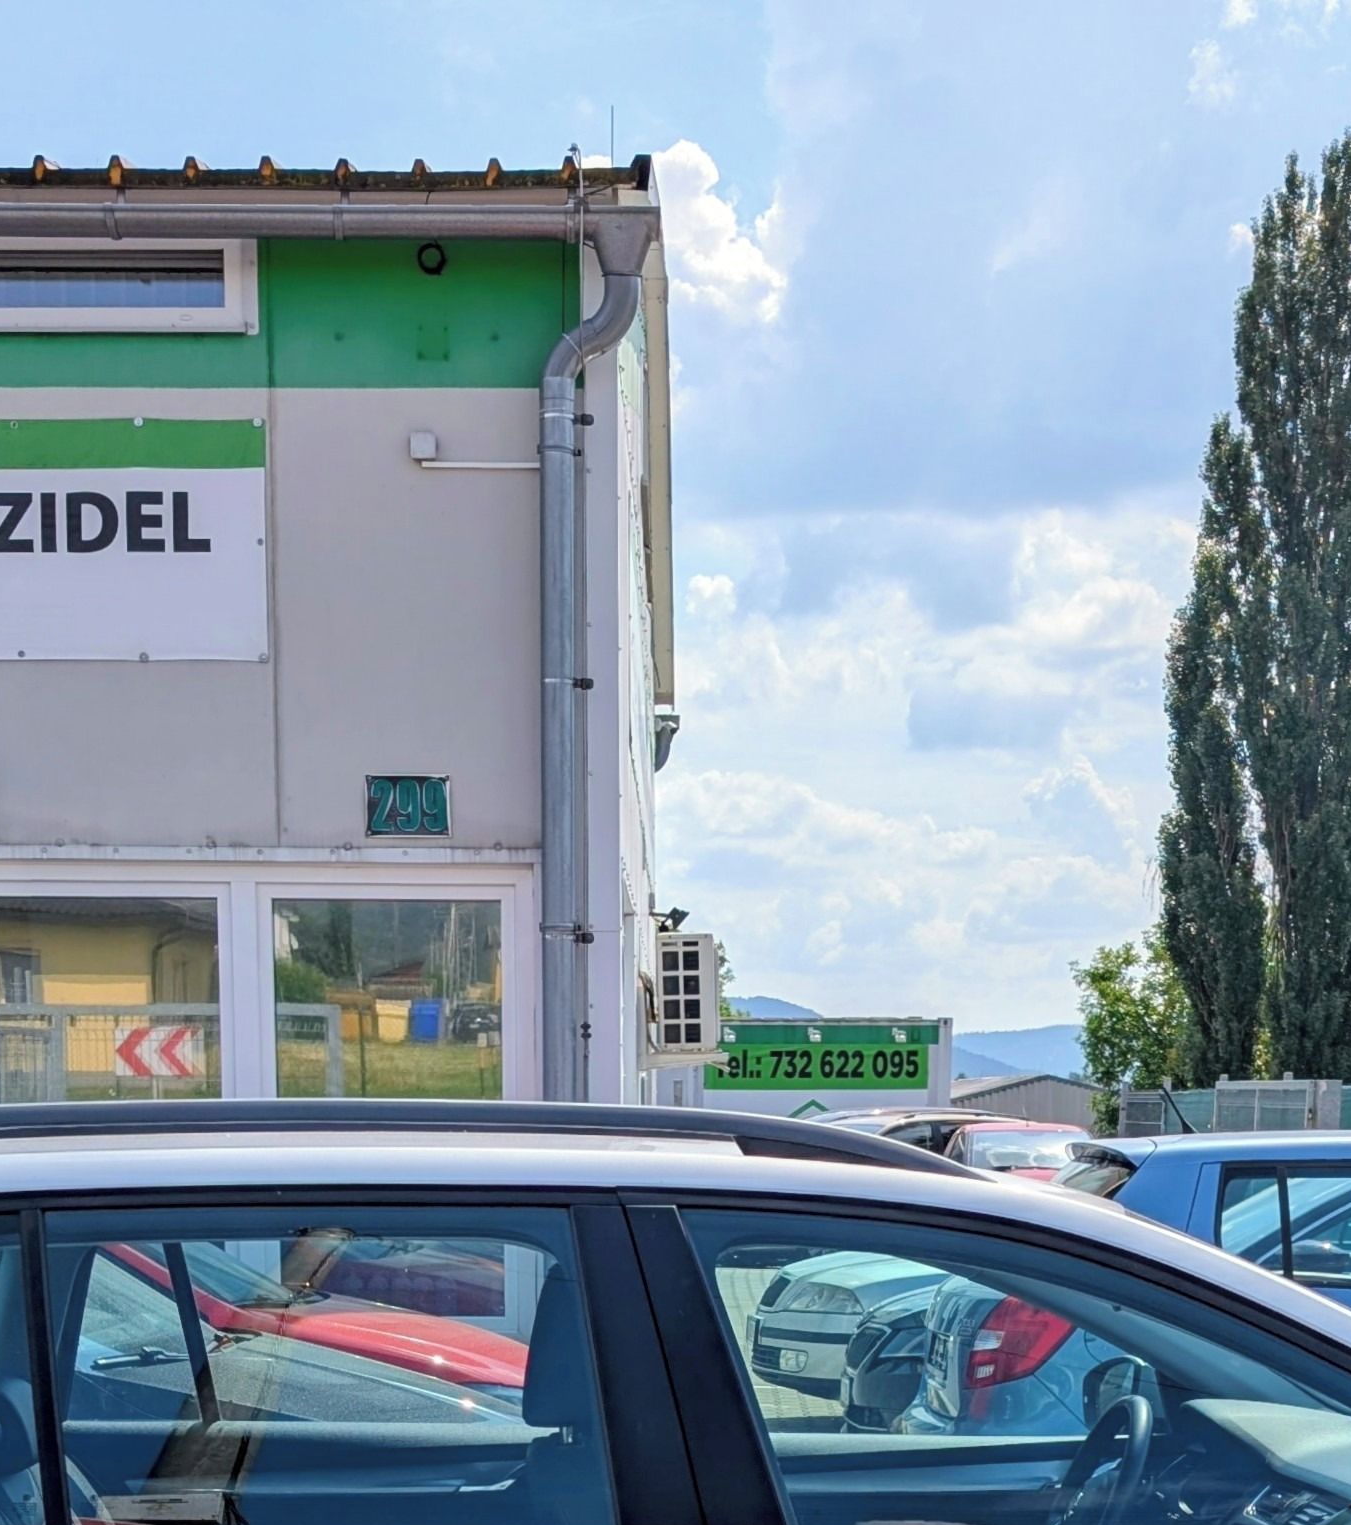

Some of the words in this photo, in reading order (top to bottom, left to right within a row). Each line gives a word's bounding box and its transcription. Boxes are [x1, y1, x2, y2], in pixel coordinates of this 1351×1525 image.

[370, 778, 447, 832] 299
[768, 1048, 813, 1079] 732
[819, 1048, 865, 1079] 622
[871, 1048, 920, 1079] 095
